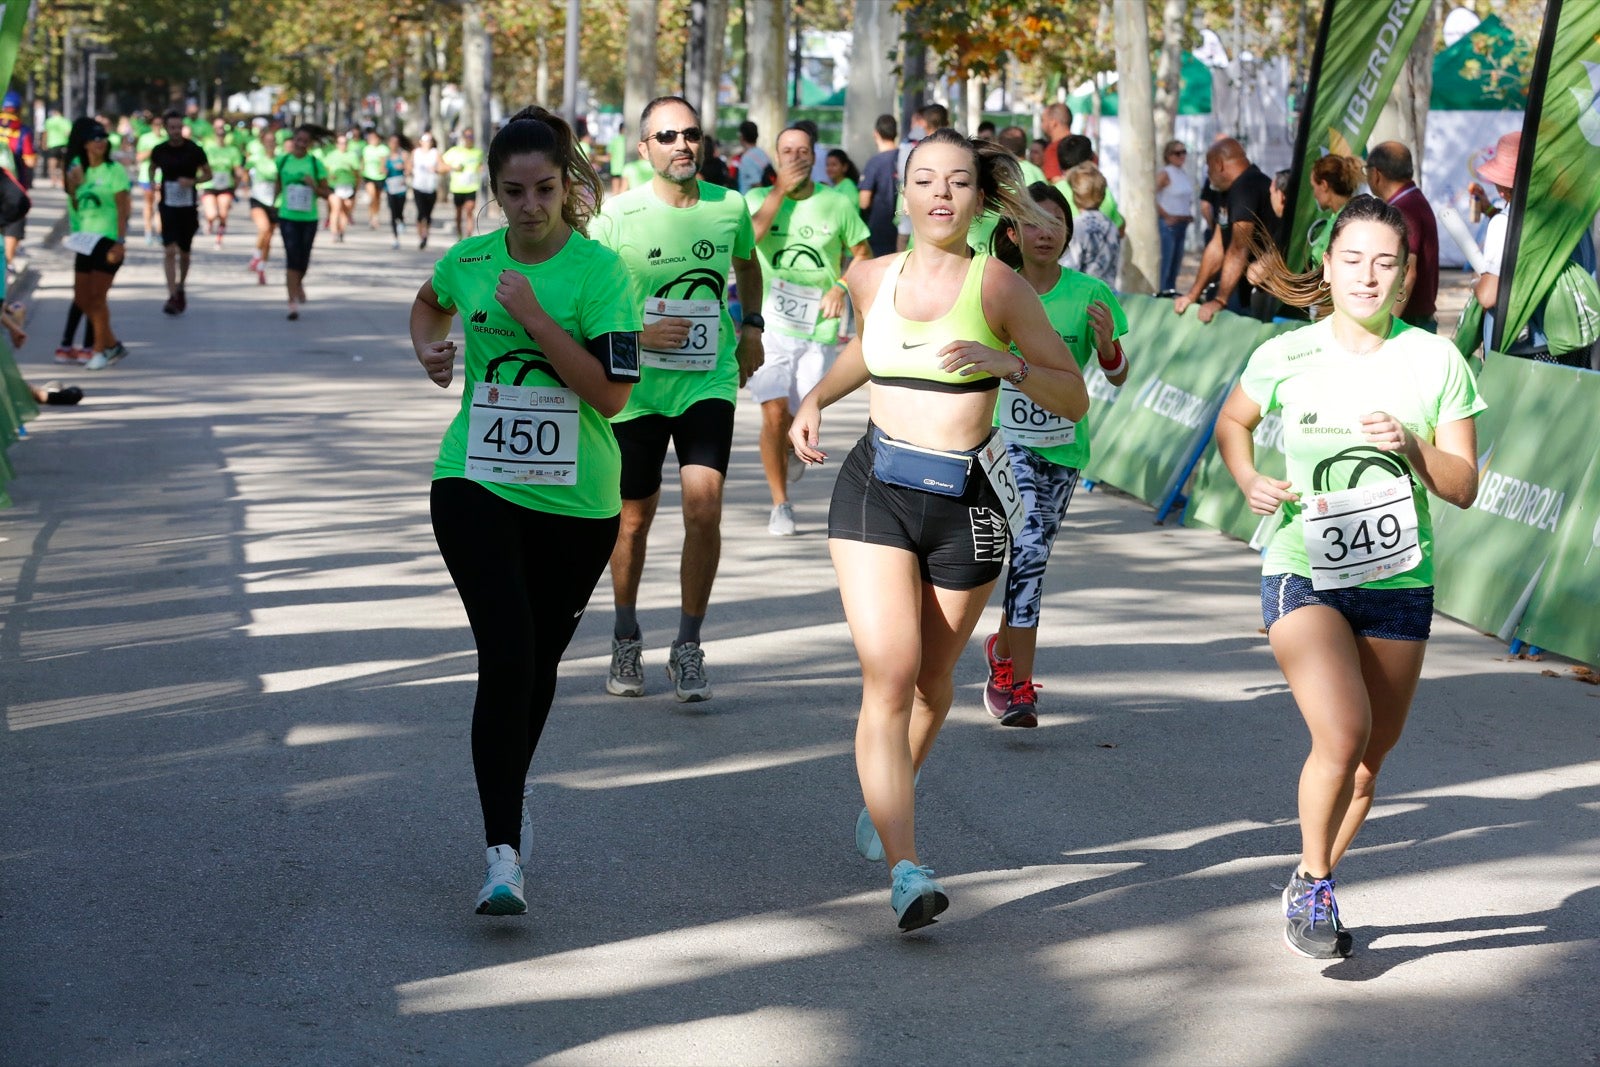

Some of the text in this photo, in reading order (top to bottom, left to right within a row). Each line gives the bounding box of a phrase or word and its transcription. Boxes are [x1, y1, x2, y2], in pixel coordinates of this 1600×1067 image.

[459, 254, 484, 264] luanvi
[650, 255, 687, 266] IBERDROLA
[774, 294, 808, 319] 321
[472, 324, 516, 338] IBERDROLA
[483, 416, 560, 456] 450
[1301, 426, 1352, 436] IBERDROLA
[1472, 469, 1565, 533] IBERDROLA
[968, 506, 994, 561] NIKE
[1321, 513, 1402, 563] 349
